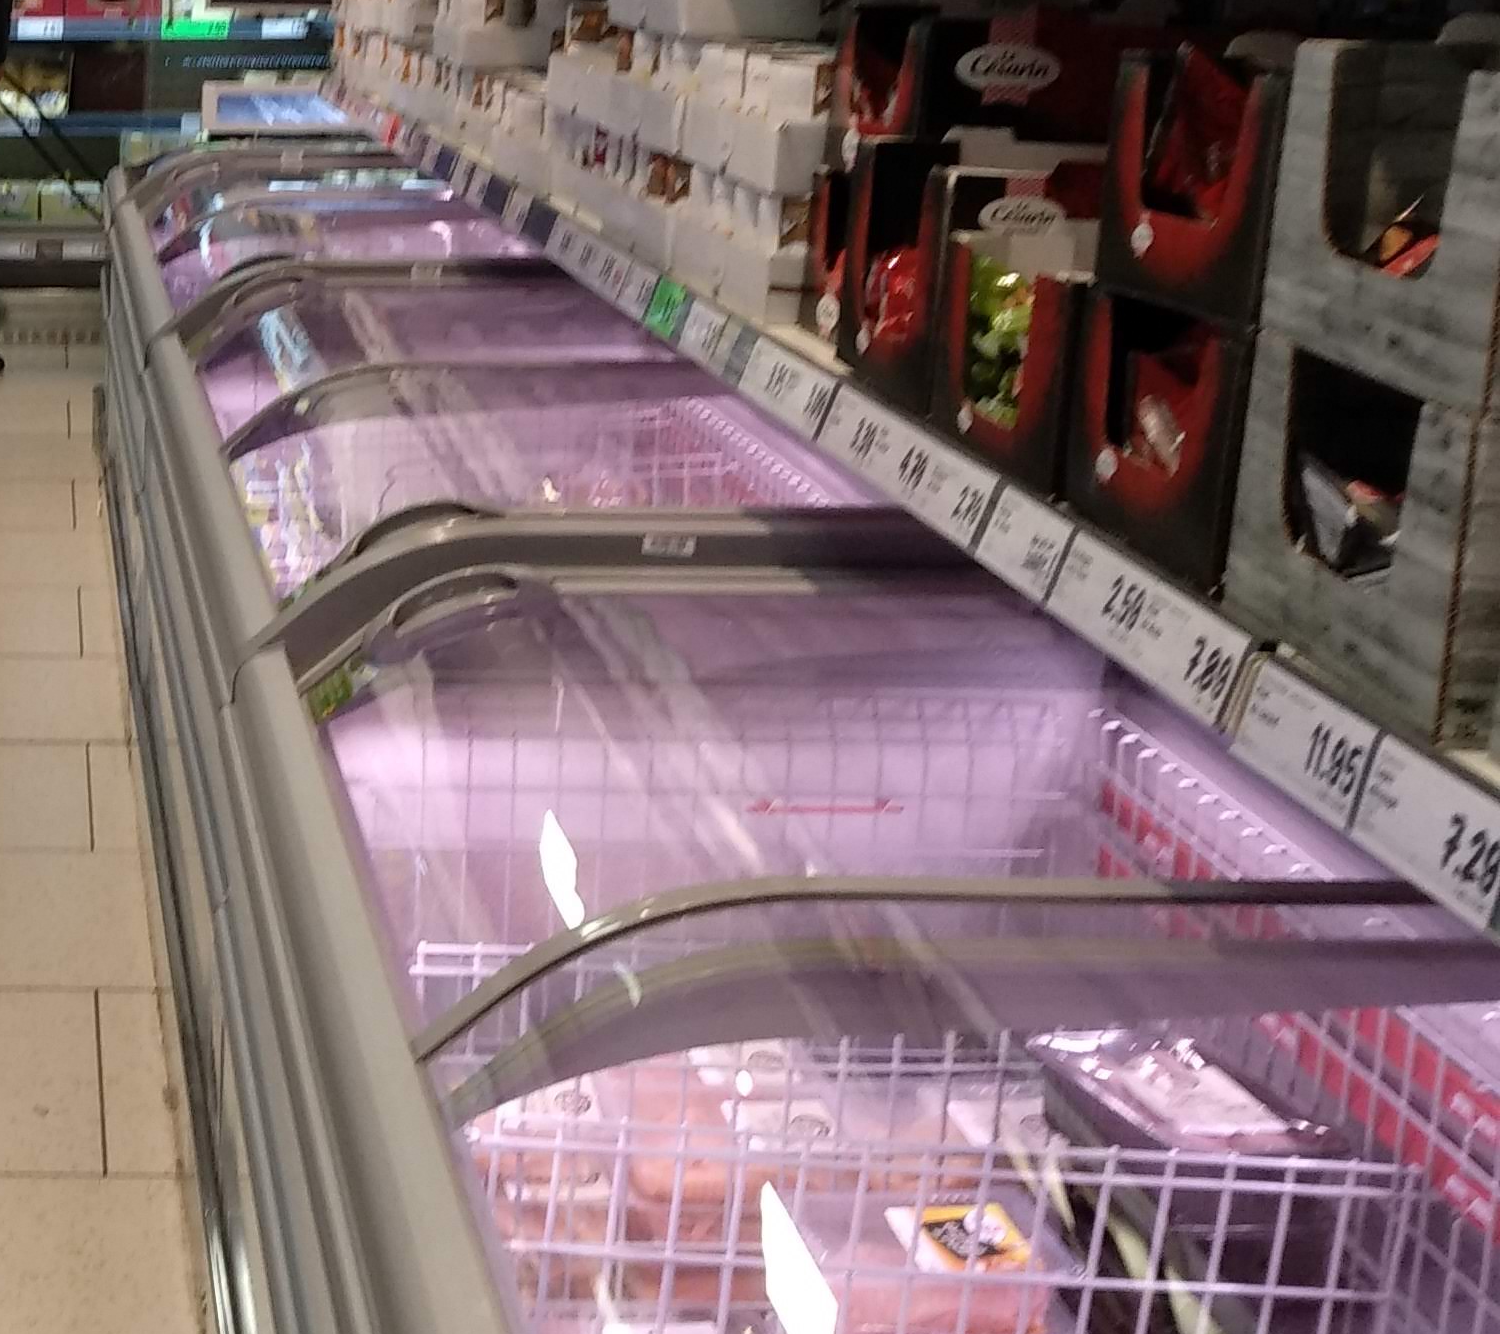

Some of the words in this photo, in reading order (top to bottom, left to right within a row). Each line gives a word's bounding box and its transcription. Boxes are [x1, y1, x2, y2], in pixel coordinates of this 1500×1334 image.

[1184, 636, 1233, 702] 7.89
[1305, 721, 1363, 797] 11.95
[1441, 813, 1500, 895] 7.29
